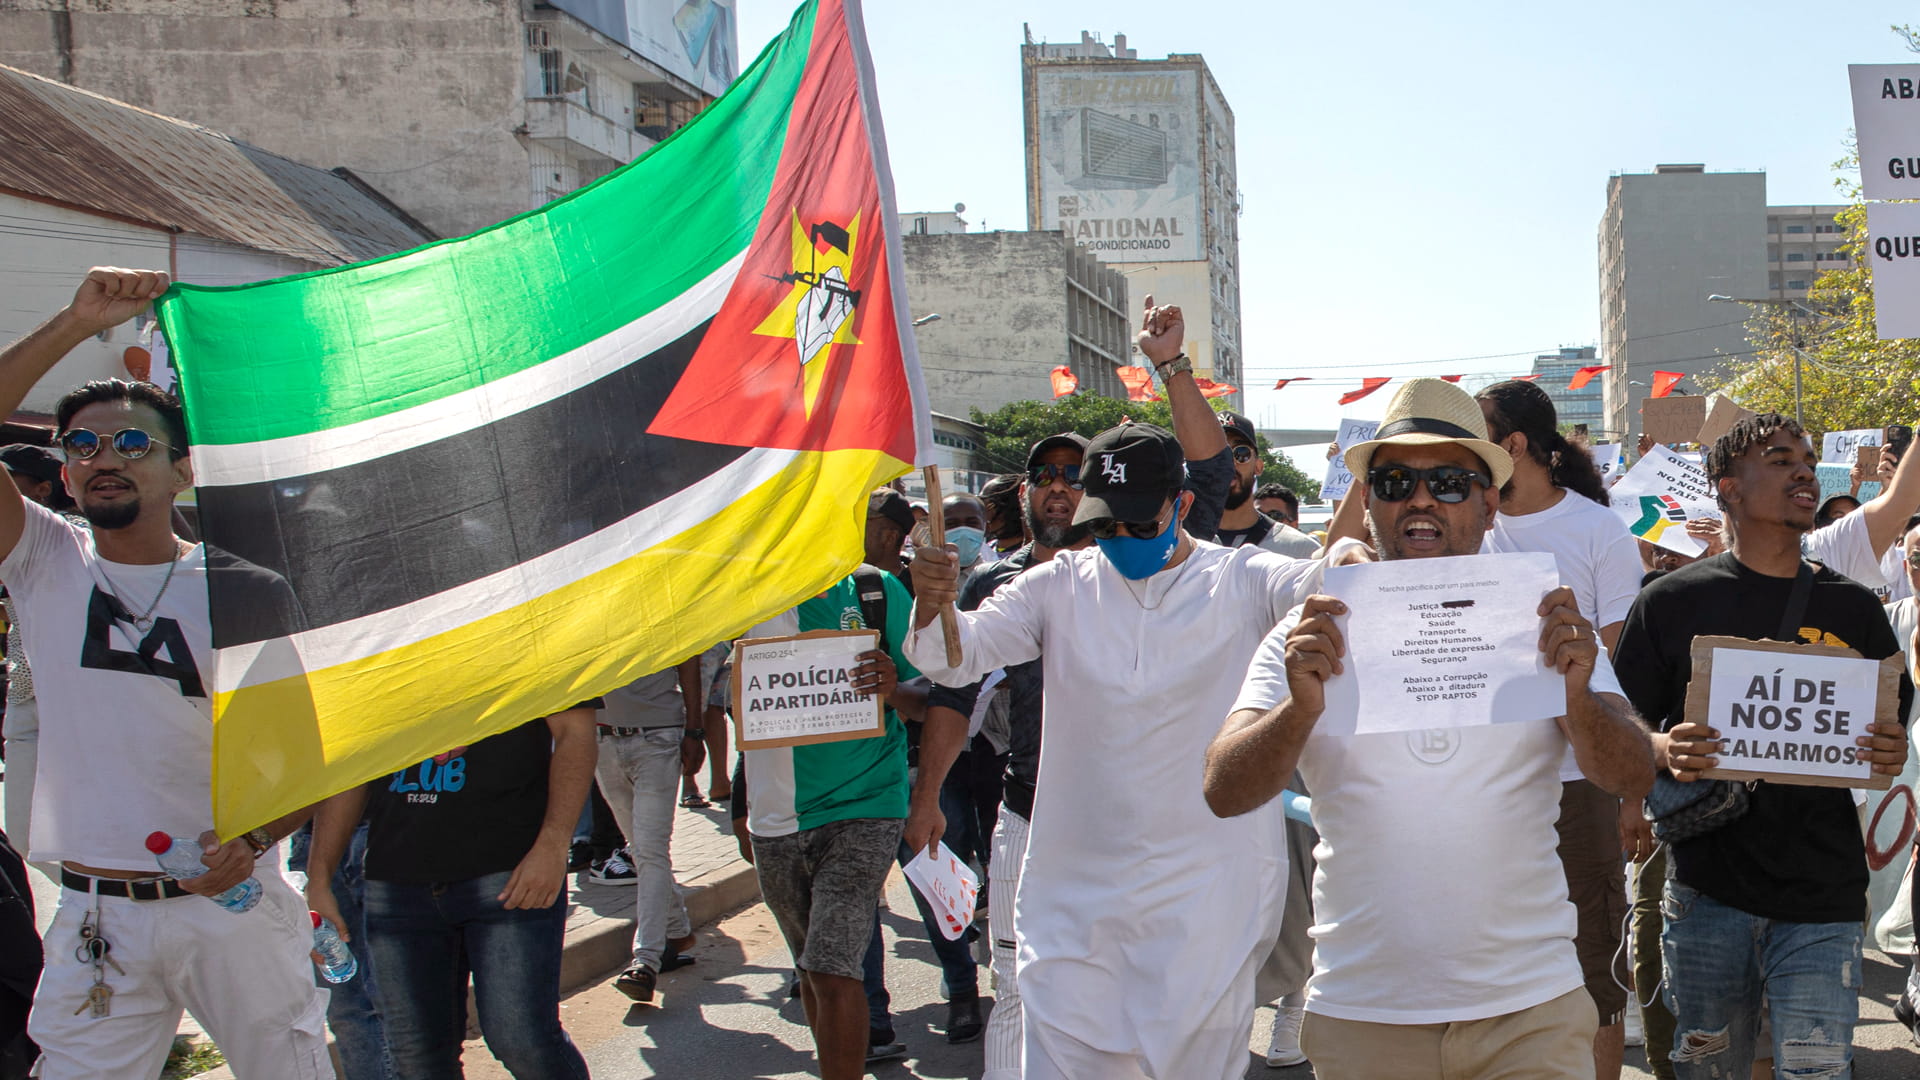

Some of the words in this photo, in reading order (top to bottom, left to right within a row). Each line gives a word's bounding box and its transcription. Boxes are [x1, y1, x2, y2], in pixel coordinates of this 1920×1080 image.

[1059, 217, 1184, 239] NATIONAL
[1088, 239, 1171, 251] CONDICIONADO
[1101, 454, 1128, 484] LA
[1657, 471, 1676, 482] NO
[1680, 472, 1707, 487] PAZ
[1408, 602, 1439, 611] Justiça
[1421, 610, 1462, 619] Educação
[1418, 629, 1467, 637] Transporte
[1441, 636, 1482, 644] Humanos
[748, 650, 776, 661] ARTIGO
[1392, 647, 1436, 657] Liberdade
[1451, 644, 1496, 653] expressão
[1421, 656, 1467, 664] Segurança
[748, 675, 762, 691] A
[768, 665, 849, 690] POLÍCIA
[1403, 676, 1433, 684] Abaixo
[1443, 672, 1488, 682] Corrupção
[1449, 682, 1486, 690] ditadura
[1745, 668, 1784, 701] AÍ
[1793, 678, 1836, 705] DE
[1416, 694, 1440, 702] STOP
[1442, 692, 1478, 700] RAPTOS
[1731, 703, 1802, 733] NOS
[1813, 710, 1850, 735] SE
